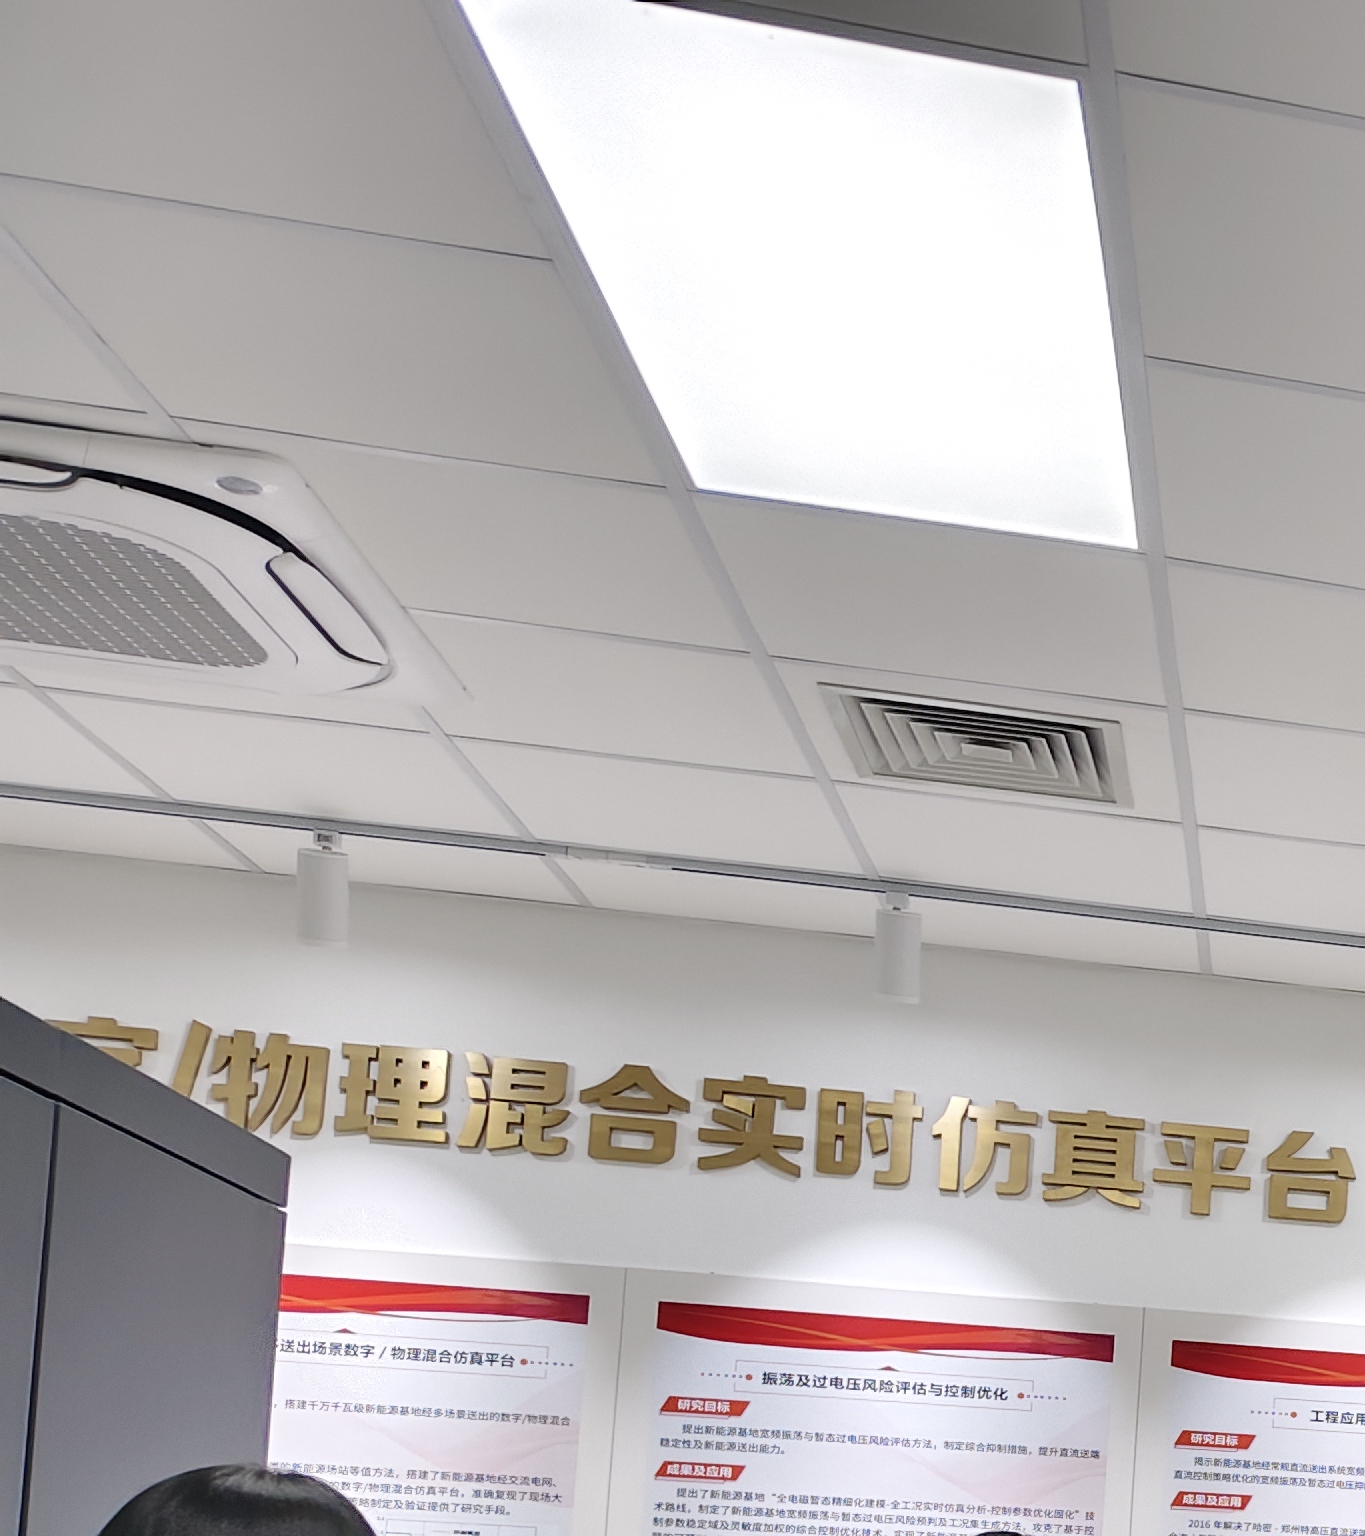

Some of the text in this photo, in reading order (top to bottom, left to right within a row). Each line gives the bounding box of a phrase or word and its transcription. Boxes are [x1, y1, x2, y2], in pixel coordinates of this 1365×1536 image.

[274, 1337, 375, 1359] 送出场景数字
[390, 1346, 515, 1368] 物理混合仿真平台
[762, 1371, 1009, 1402] 振荡及过电压风险评估与控制优化
[677, 1398, 731, 1414] 研究目标
[1190, 1432, 1239, 1447] 研究目标
[666, 1462, 732, 1478] 成果及应用
[1182, 1492, 1242, 1508] 成果及应用
[1187, 1518, 1211, 1529] 2016
